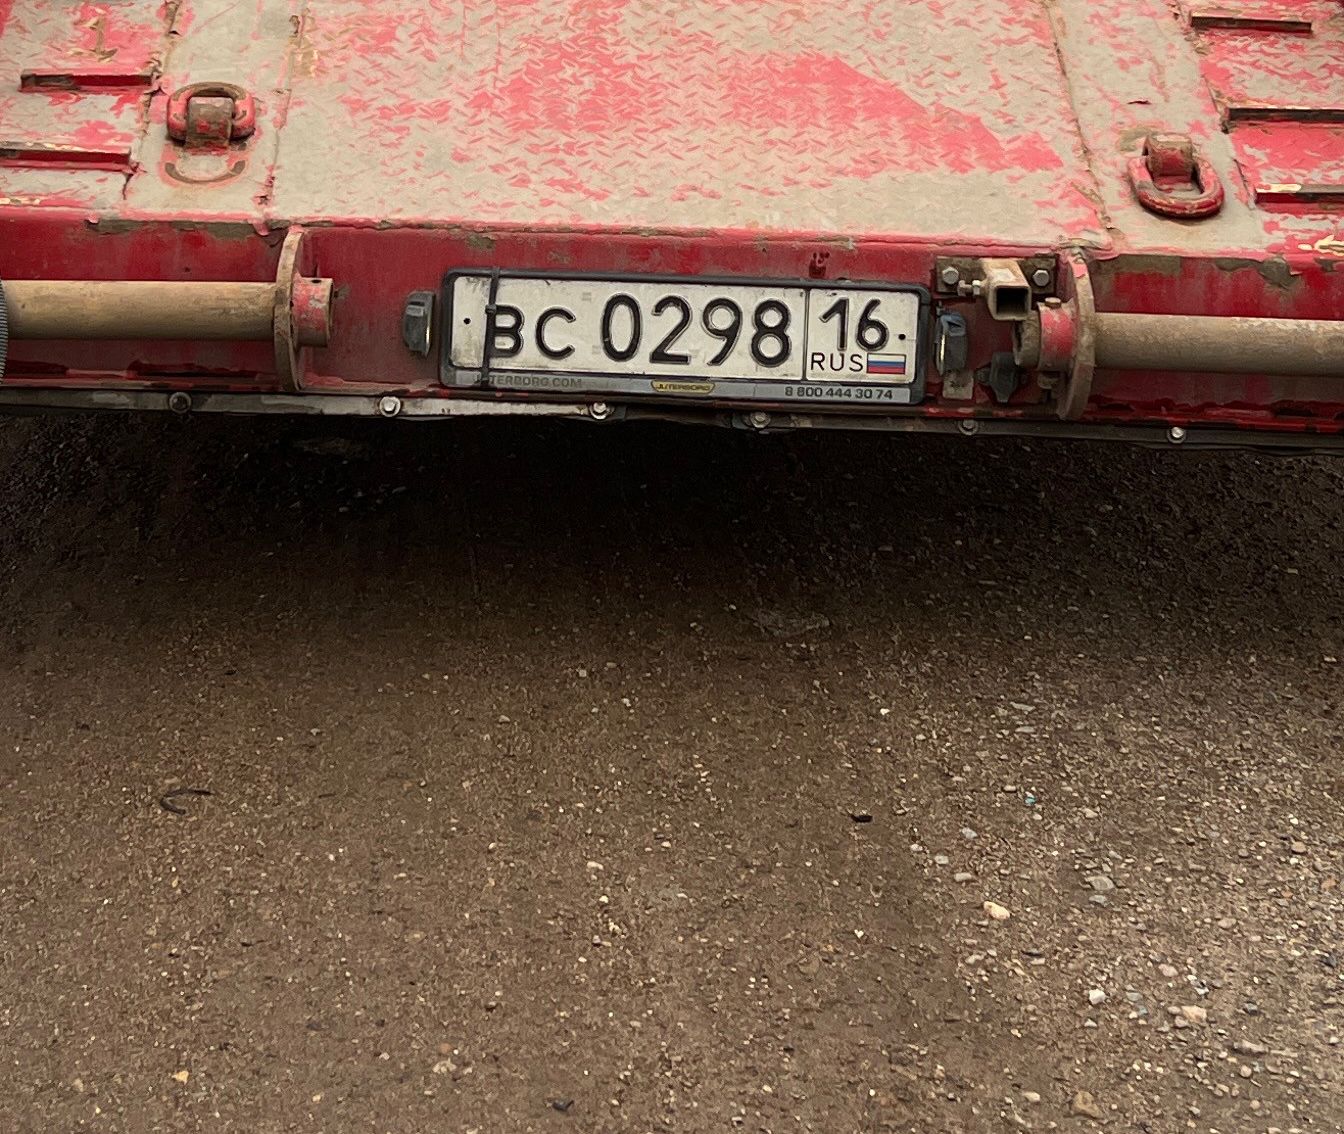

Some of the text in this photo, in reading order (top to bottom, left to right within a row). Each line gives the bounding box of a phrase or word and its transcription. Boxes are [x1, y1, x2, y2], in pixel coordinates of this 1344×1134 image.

[602, 292, 792, 368] 0298
[818, 296, 890, 352] 16
[810, 353, 863, 372] RUS
[474, 374, 584, 388] JTERBORG.COM
[784, 386, 893, 400] 8 800 444 30 74
